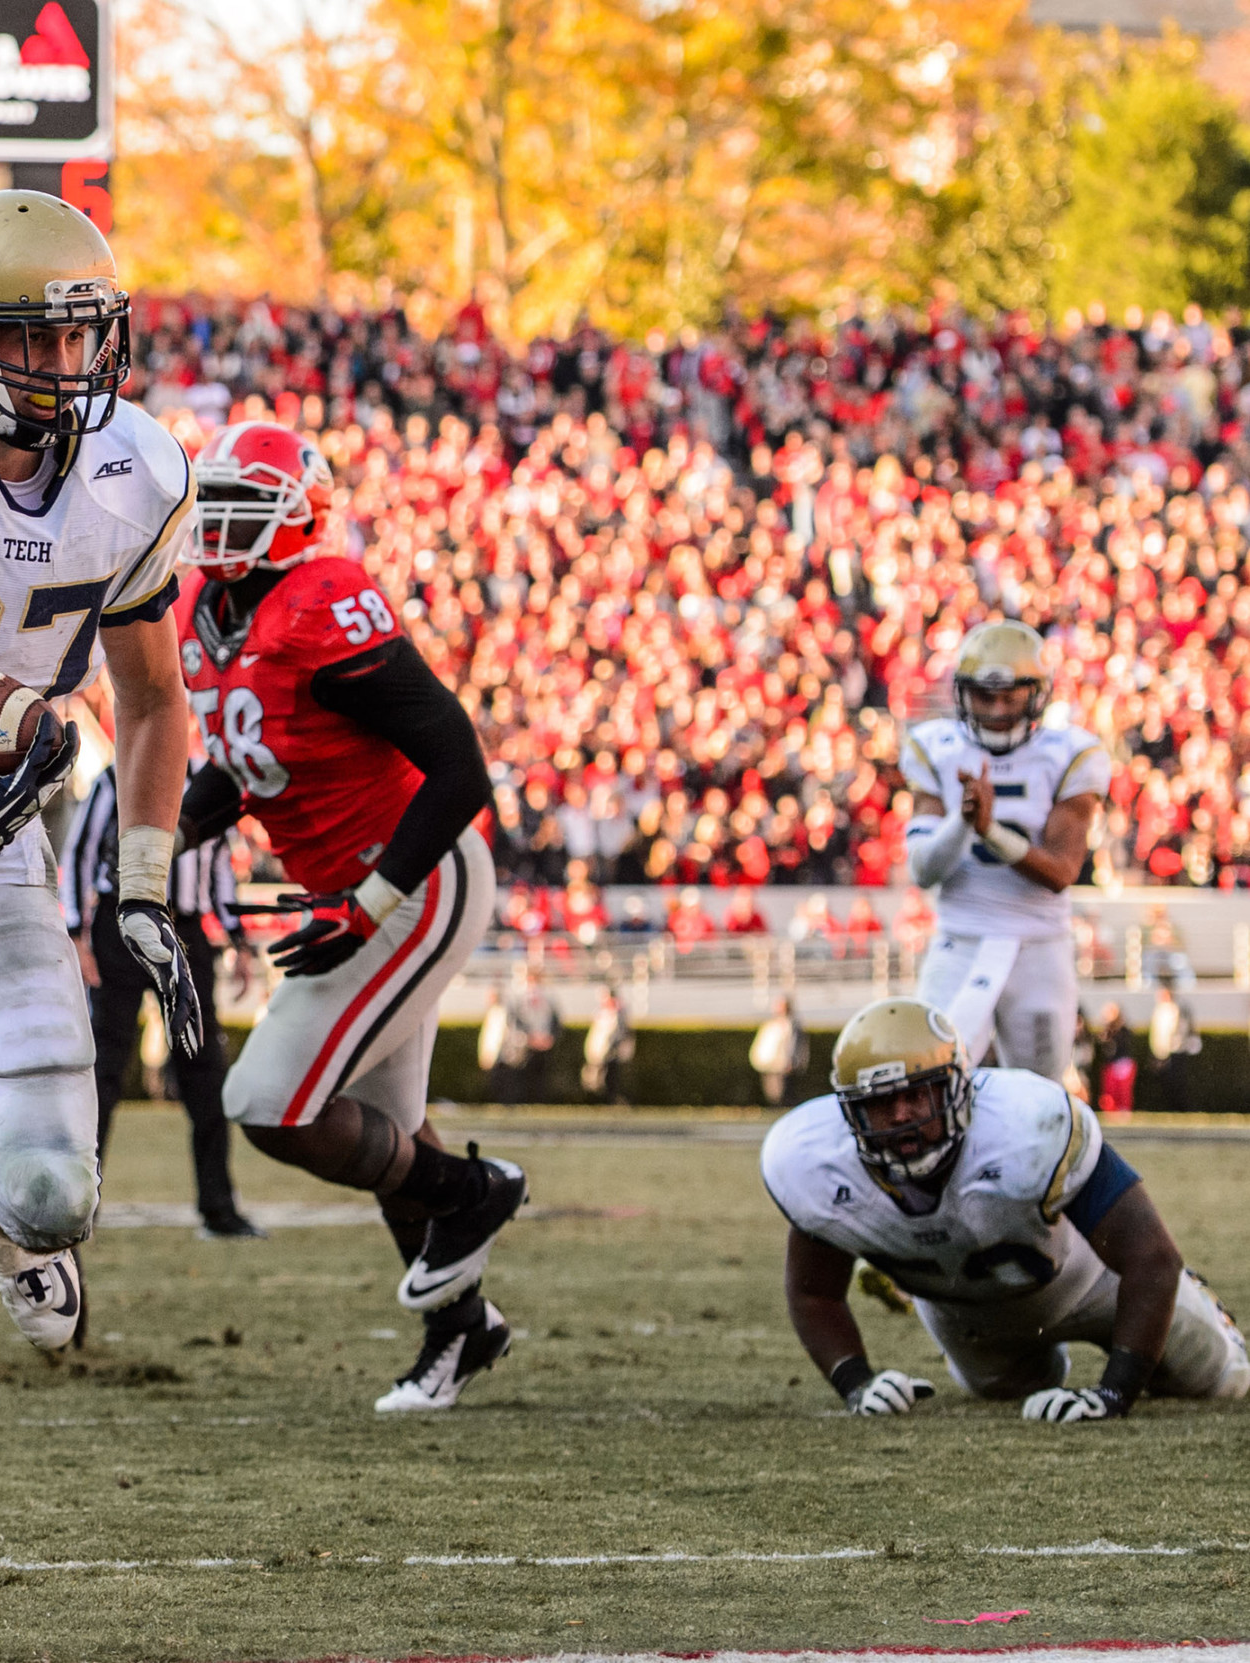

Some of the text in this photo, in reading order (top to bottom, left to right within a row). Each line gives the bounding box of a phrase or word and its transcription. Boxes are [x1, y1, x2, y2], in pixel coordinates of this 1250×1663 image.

[65, 282, 95, 295] ACC
[87, 338, 113, 377] Riddell
[96, 458, 133, 478] ACC
[3, 537, 53, 564] TECH
[330, 588, 395, 646] 58
[187, 685, 291, 799] 58
